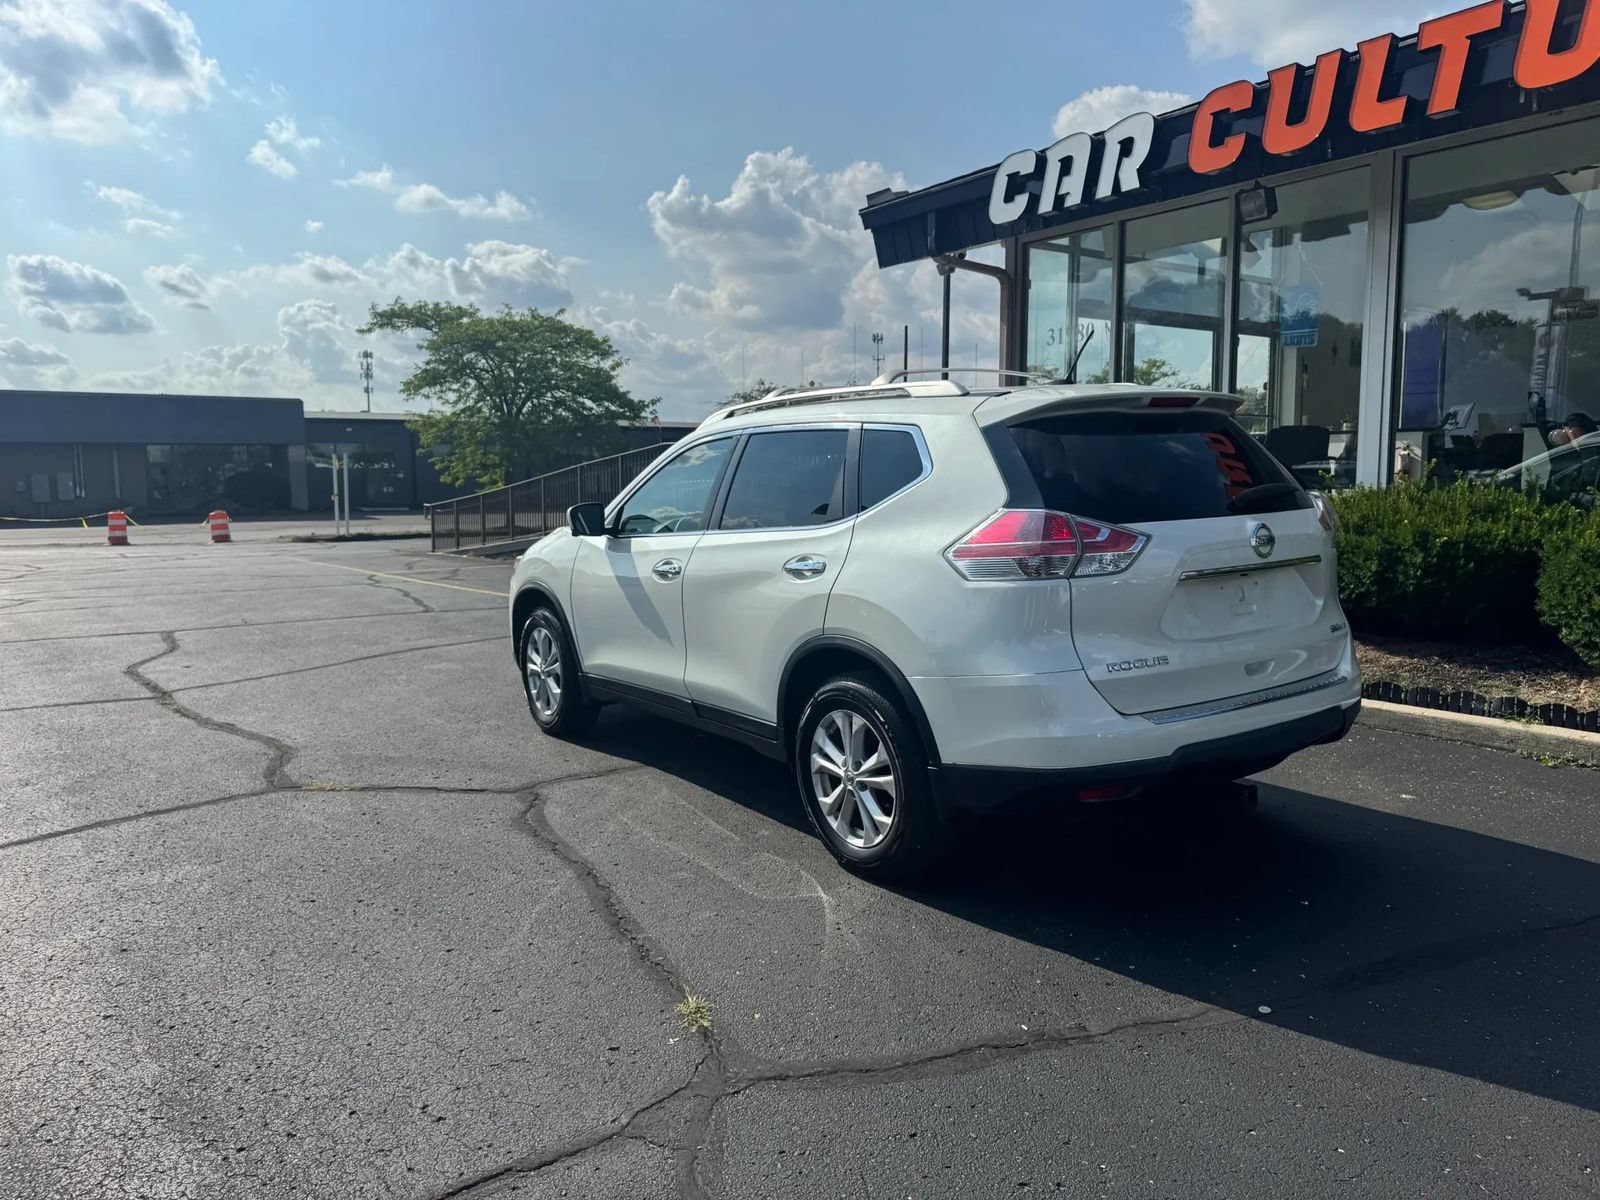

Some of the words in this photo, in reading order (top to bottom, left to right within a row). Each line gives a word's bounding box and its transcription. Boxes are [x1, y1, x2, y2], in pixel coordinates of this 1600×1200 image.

[988, 112, 1155, 225] CAR
[1187, 0, 1600, 174] CULTU
[1046, 322, 1095, 346] 3180
[1106, 655, 1169, 673] ROGUE
